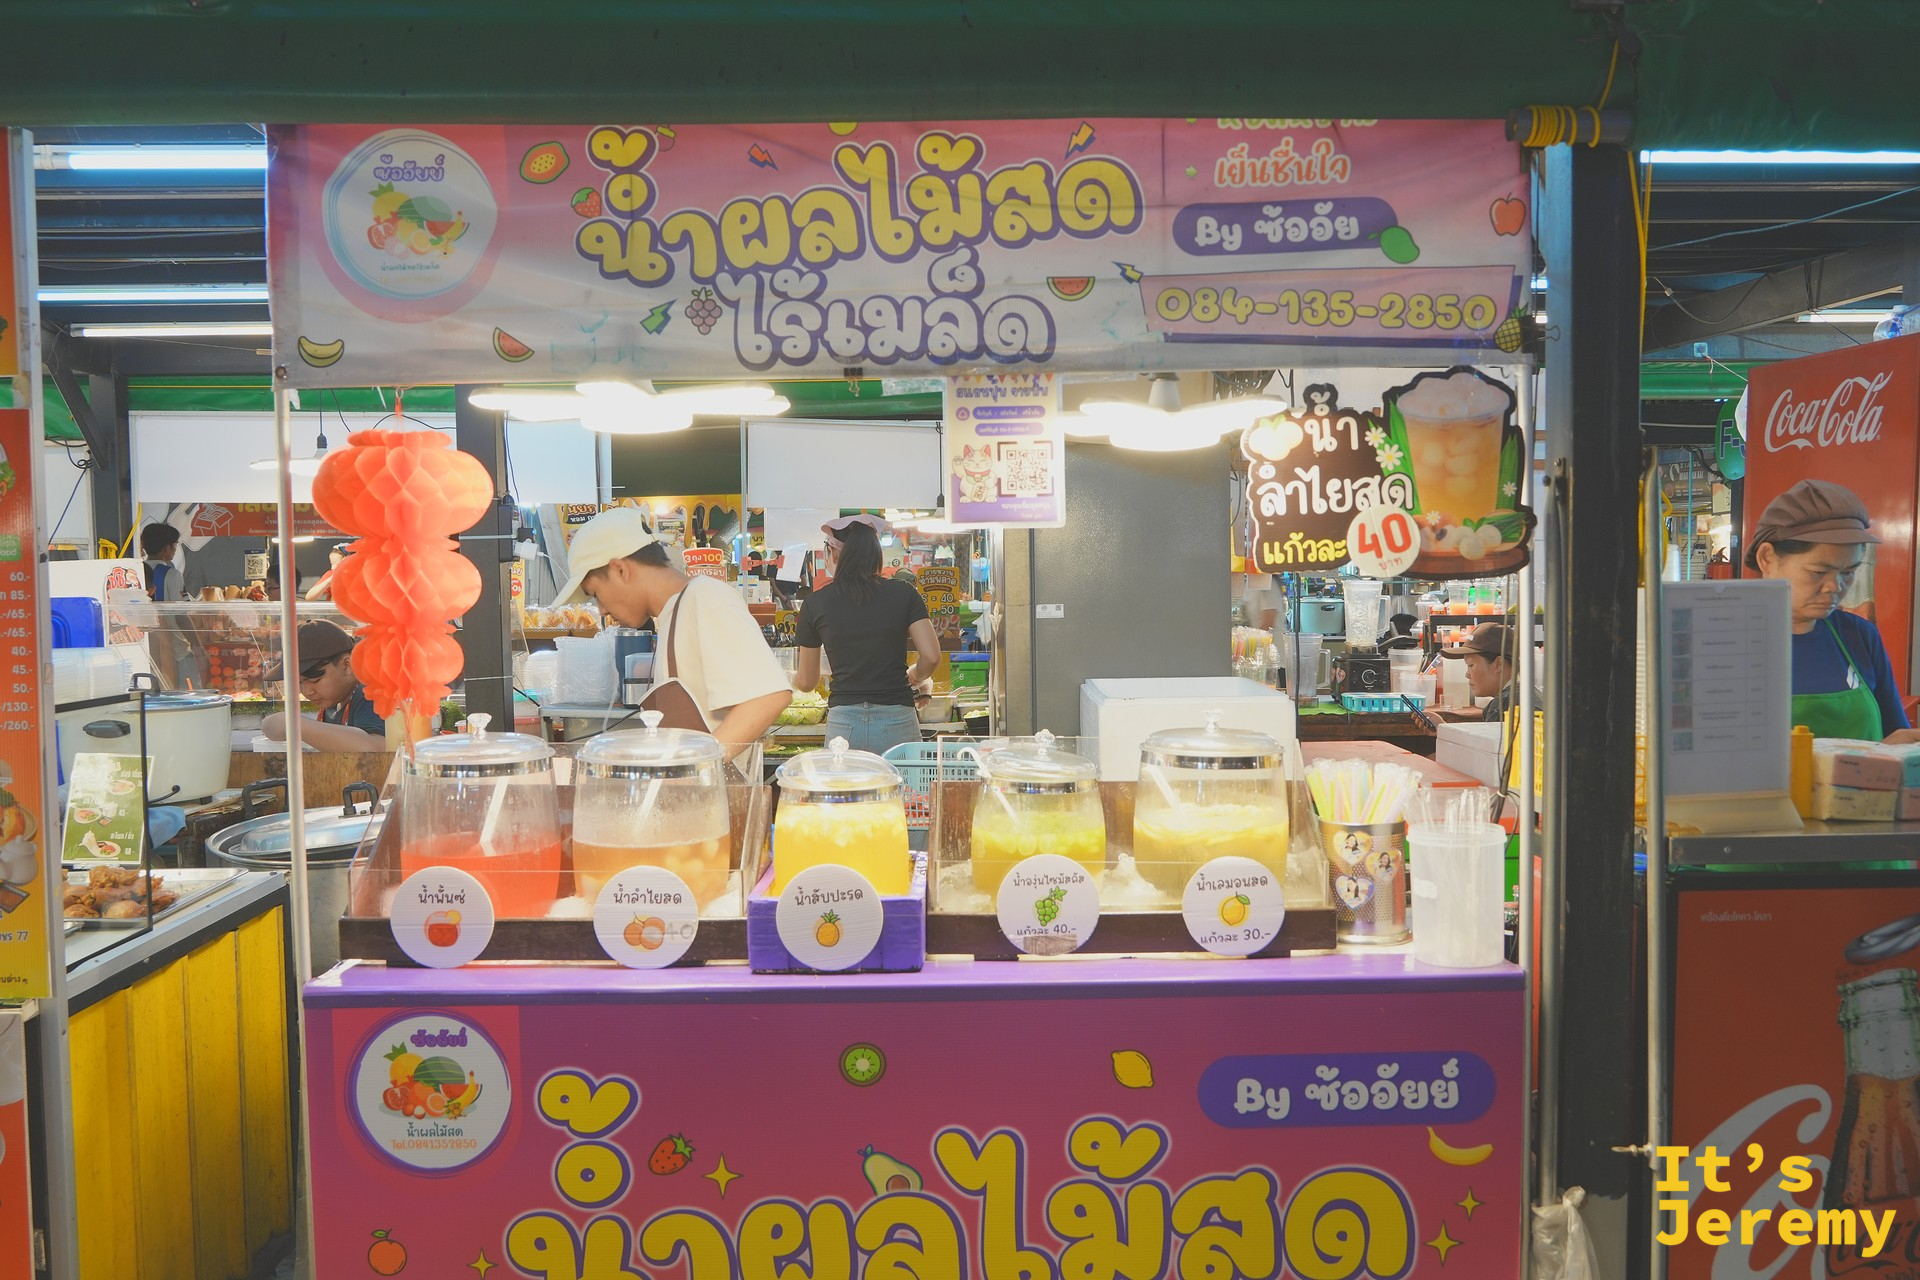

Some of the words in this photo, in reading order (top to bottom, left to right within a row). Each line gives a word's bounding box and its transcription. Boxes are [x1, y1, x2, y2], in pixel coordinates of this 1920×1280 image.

[1215, 137, 1350, 187] เย็นชื่นใจ
[575, 126, 1144, 288] น้ำผลไม้สด
[1194, 216, 1242, 251] By
[715, 248, 1055, 370] ไร้เมล็ด
[1156, 287, 1496, 330] 084-135-2850
[1304, 391, 1359, 452] น้ำ
[1764, 370, 1894, 453] Coca-Cola
[1257, 464, 1414, 516] ลำไยสด
[1264, 532, 1347, 565] แก้วละ
[1358, 513, 1411, 559] 40
[613, 883, 682, 904] น้ำลำไยสด
[1197, 873, 1268, 891] น้ำเลมอนสด
[1053, 924, 1076, 934] 40.-
[1200, 931, 1238, 944] แก้วละ
[1243, 928, 1271, 940] 30.-
[1233, 1077, 1290, 1120] By
[407, 1122, 463, 1137] น้ำผลไม้สด
